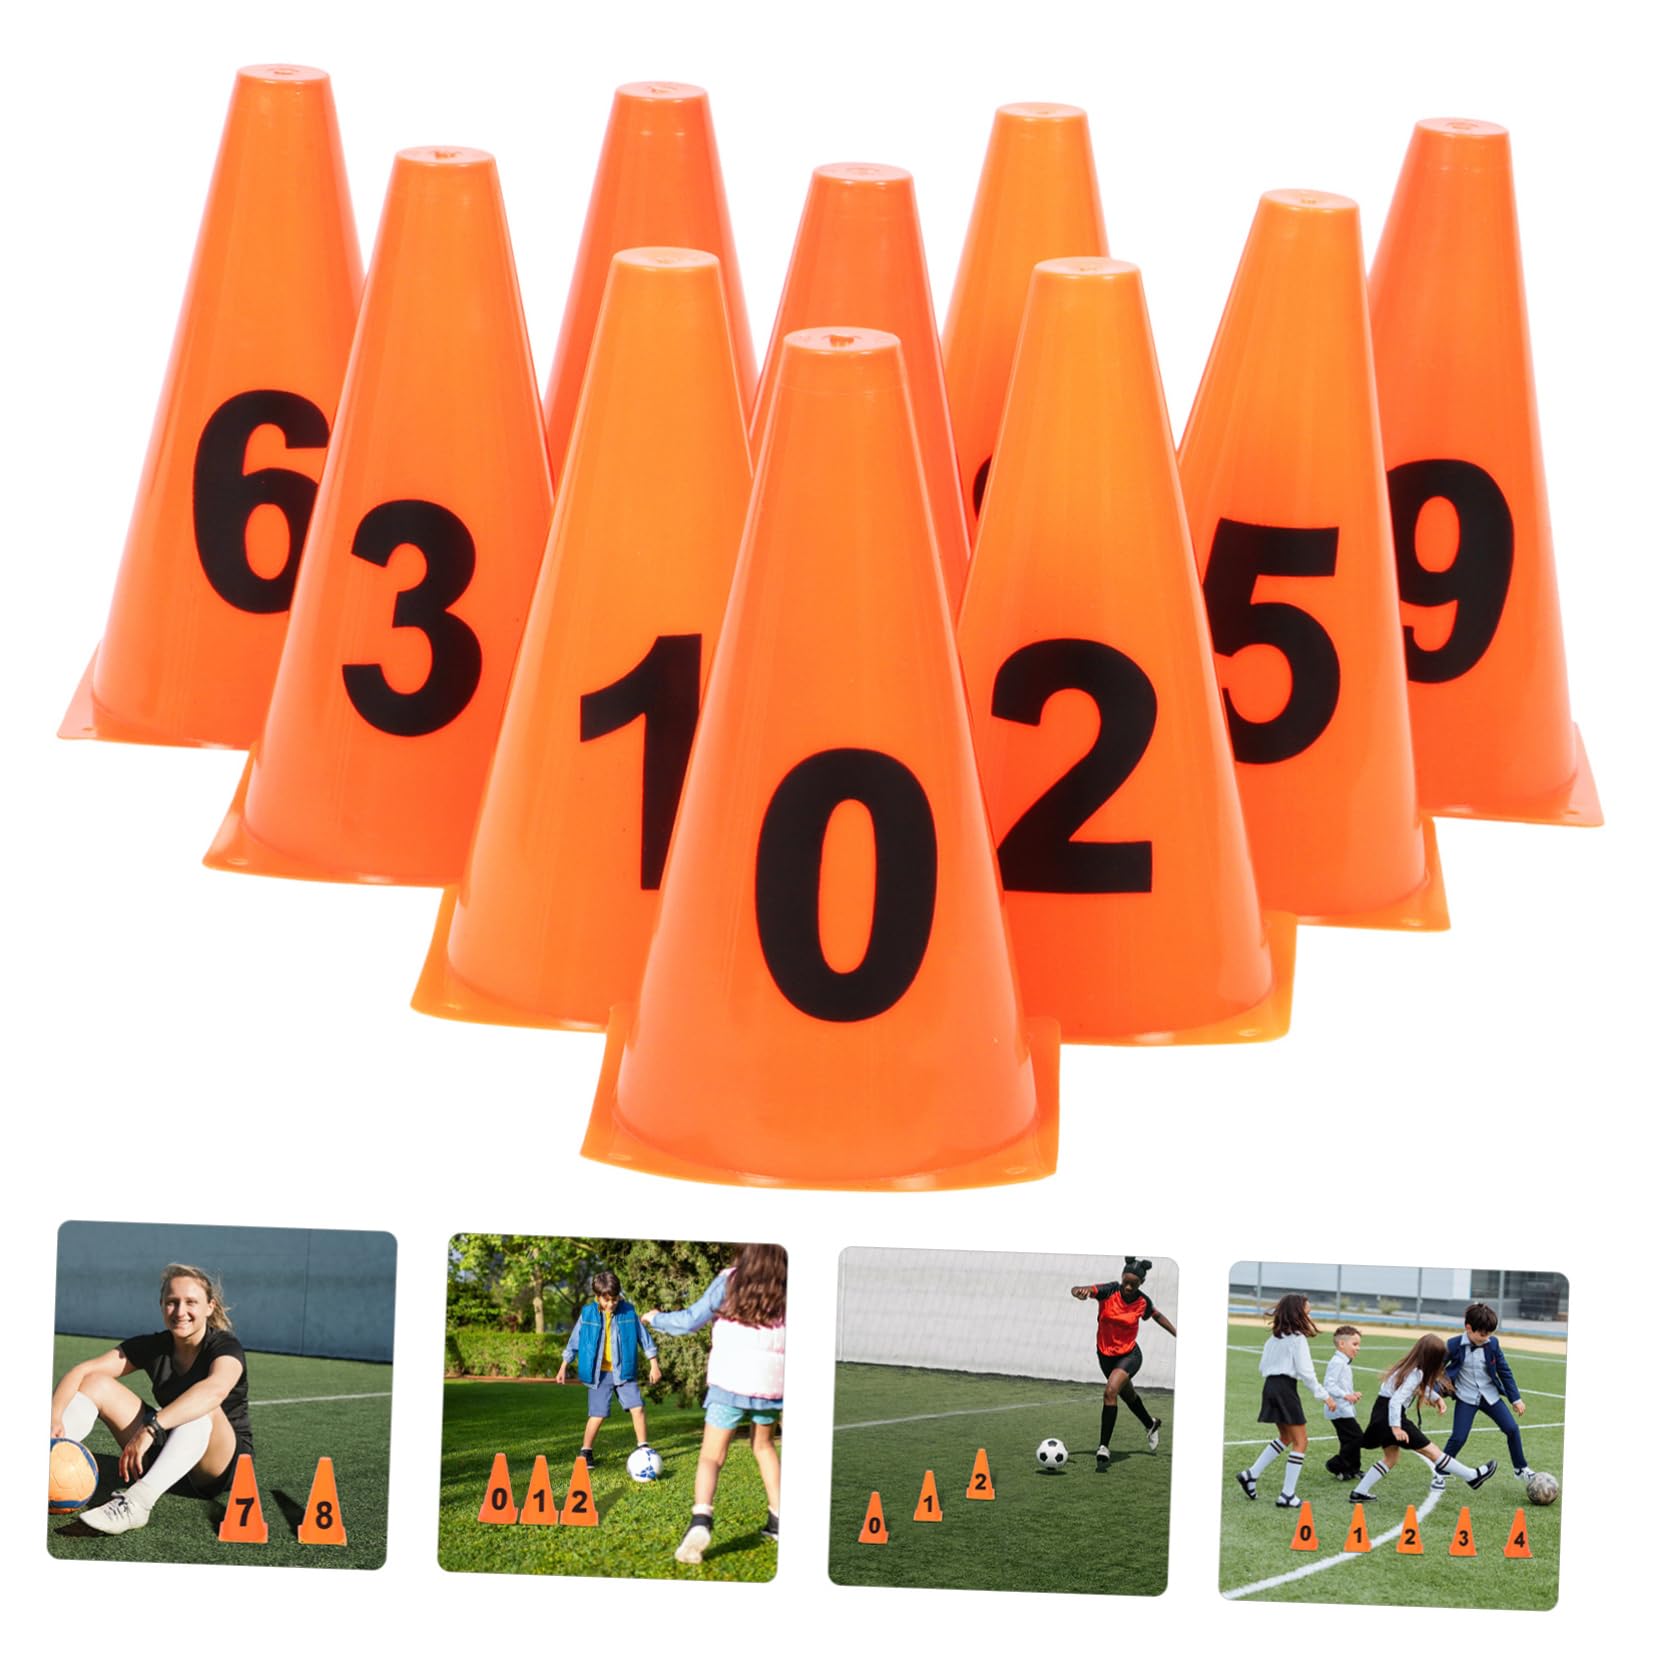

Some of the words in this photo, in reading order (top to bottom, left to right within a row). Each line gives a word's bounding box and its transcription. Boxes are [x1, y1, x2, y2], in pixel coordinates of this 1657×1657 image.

[195, 391, 328, 613] 6
[1389, 460, 1514, 682] 9
[343, 500, 481, 736] 3
[1203, 518, 1340, 764] 5
[580, 635, 702, 890] 1
[991, 638, 1158, 893] 2
[756, 748, 937, 1022] 0
[975, 1473, 987, 1491] 2
[492, 1487, 507, 1511] 0
[533, 1490, 546, 1512] 1
[571, 1491, 587, 1513] 2
[923, 1495, 933, 1513] 1
[235, 1497, 254, 1527] 7
[315, 1501, 333, 1530] 8
[868, 1517, 881, 1534] 0
[1300, 1525, 1312, 1541] 0
[1353, 1527, 1362, 1543] 1
[1404, 1529, 1416, 1545] 2
[1458, 1530, 1469, 1546] 3
[1513, 1532, 1525, 1547] 4
